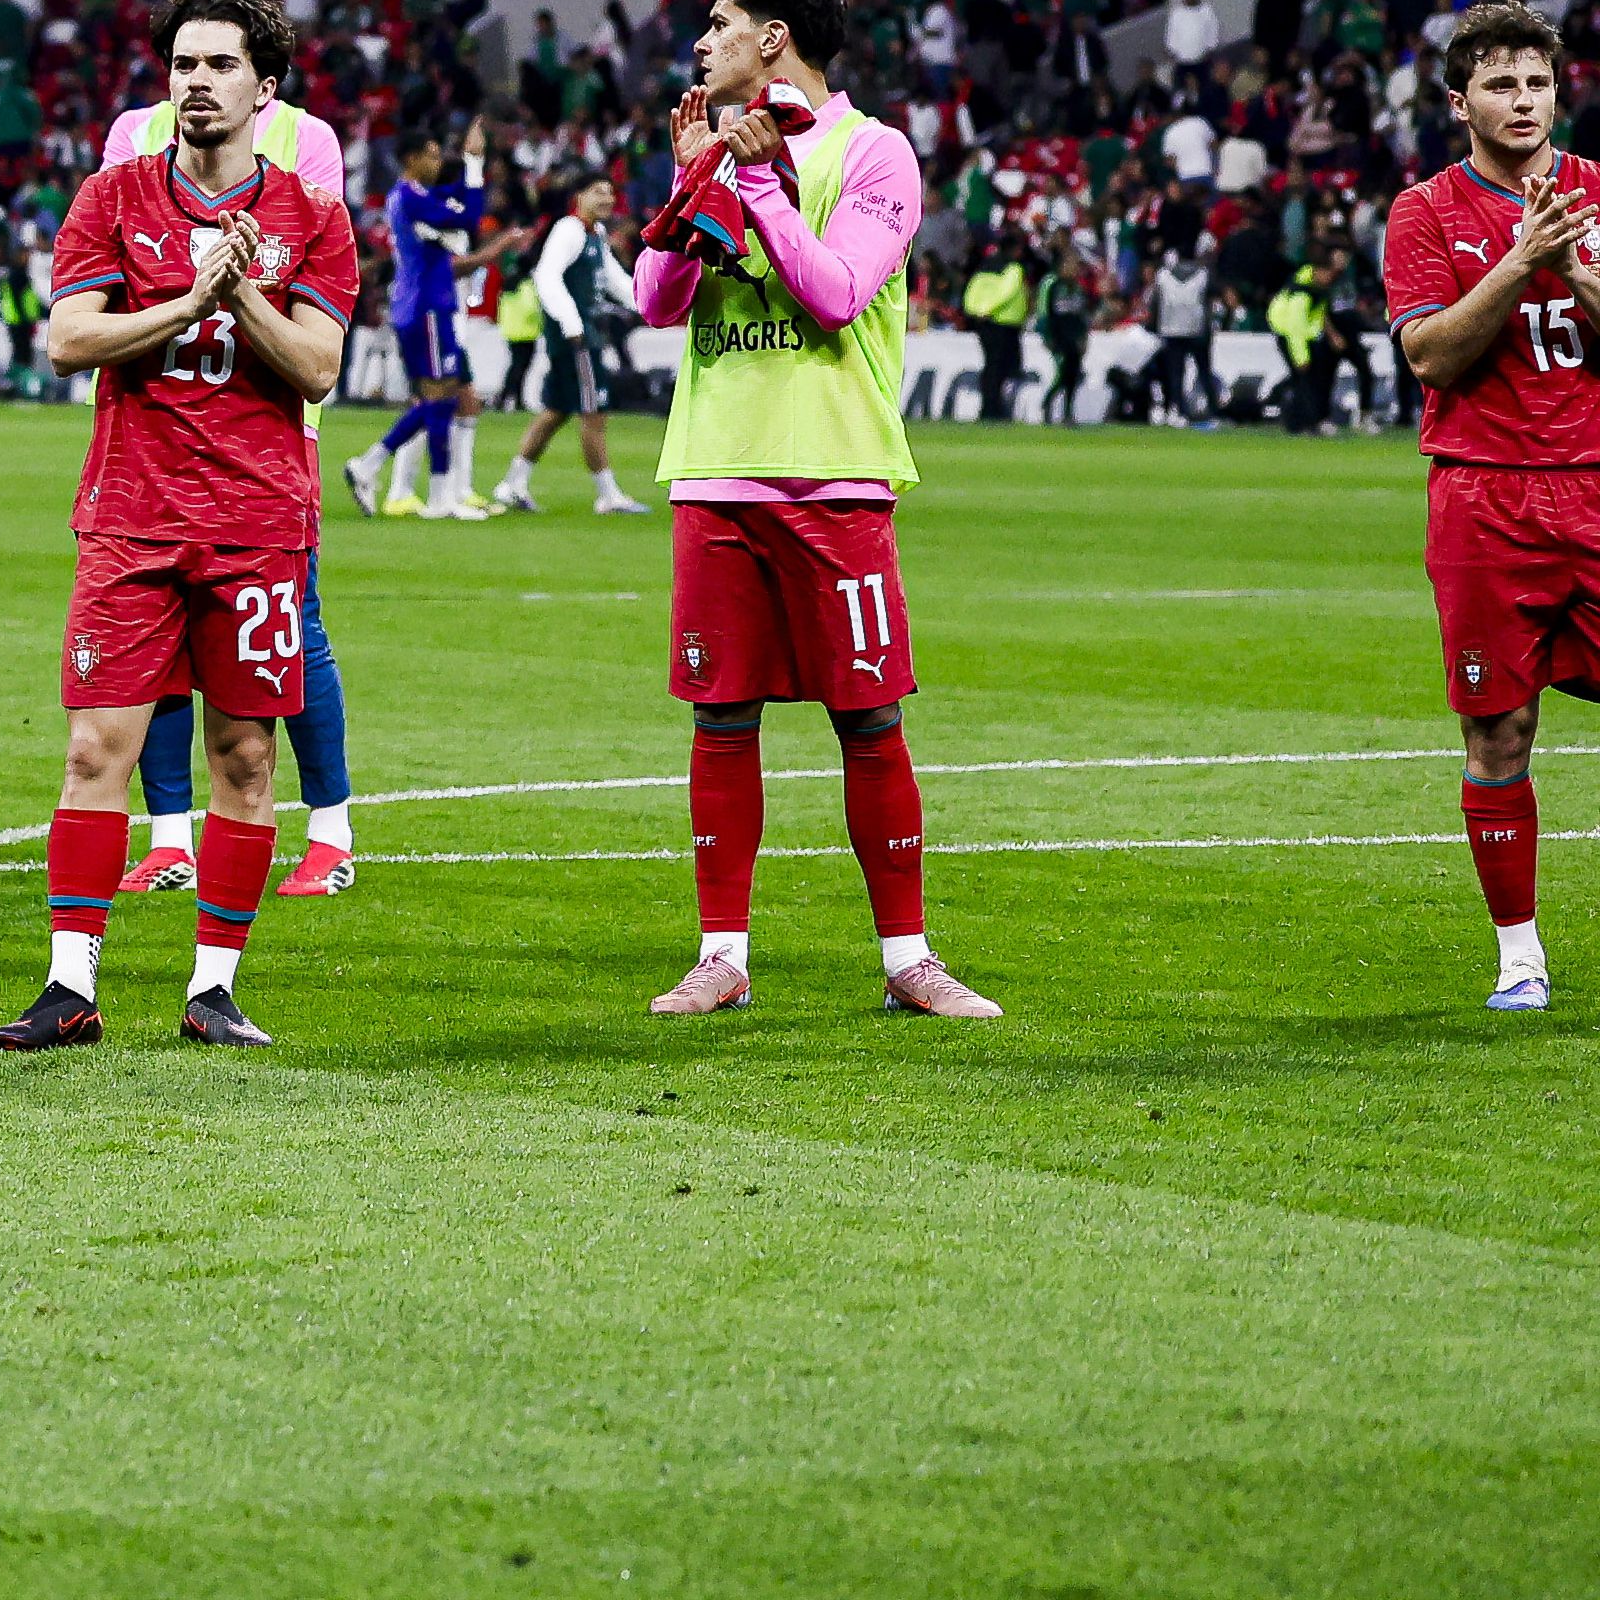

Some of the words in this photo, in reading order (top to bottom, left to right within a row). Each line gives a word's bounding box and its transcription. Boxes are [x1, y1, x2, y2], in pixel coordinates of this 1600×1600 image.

[161, 309, 237, 385] 23
[715, 315, 804, 357] SAGRES
[1520, 296, 1584, 372] 15
[236, 579, 303, 662] 23
[836, 572, 892, 652] 11
